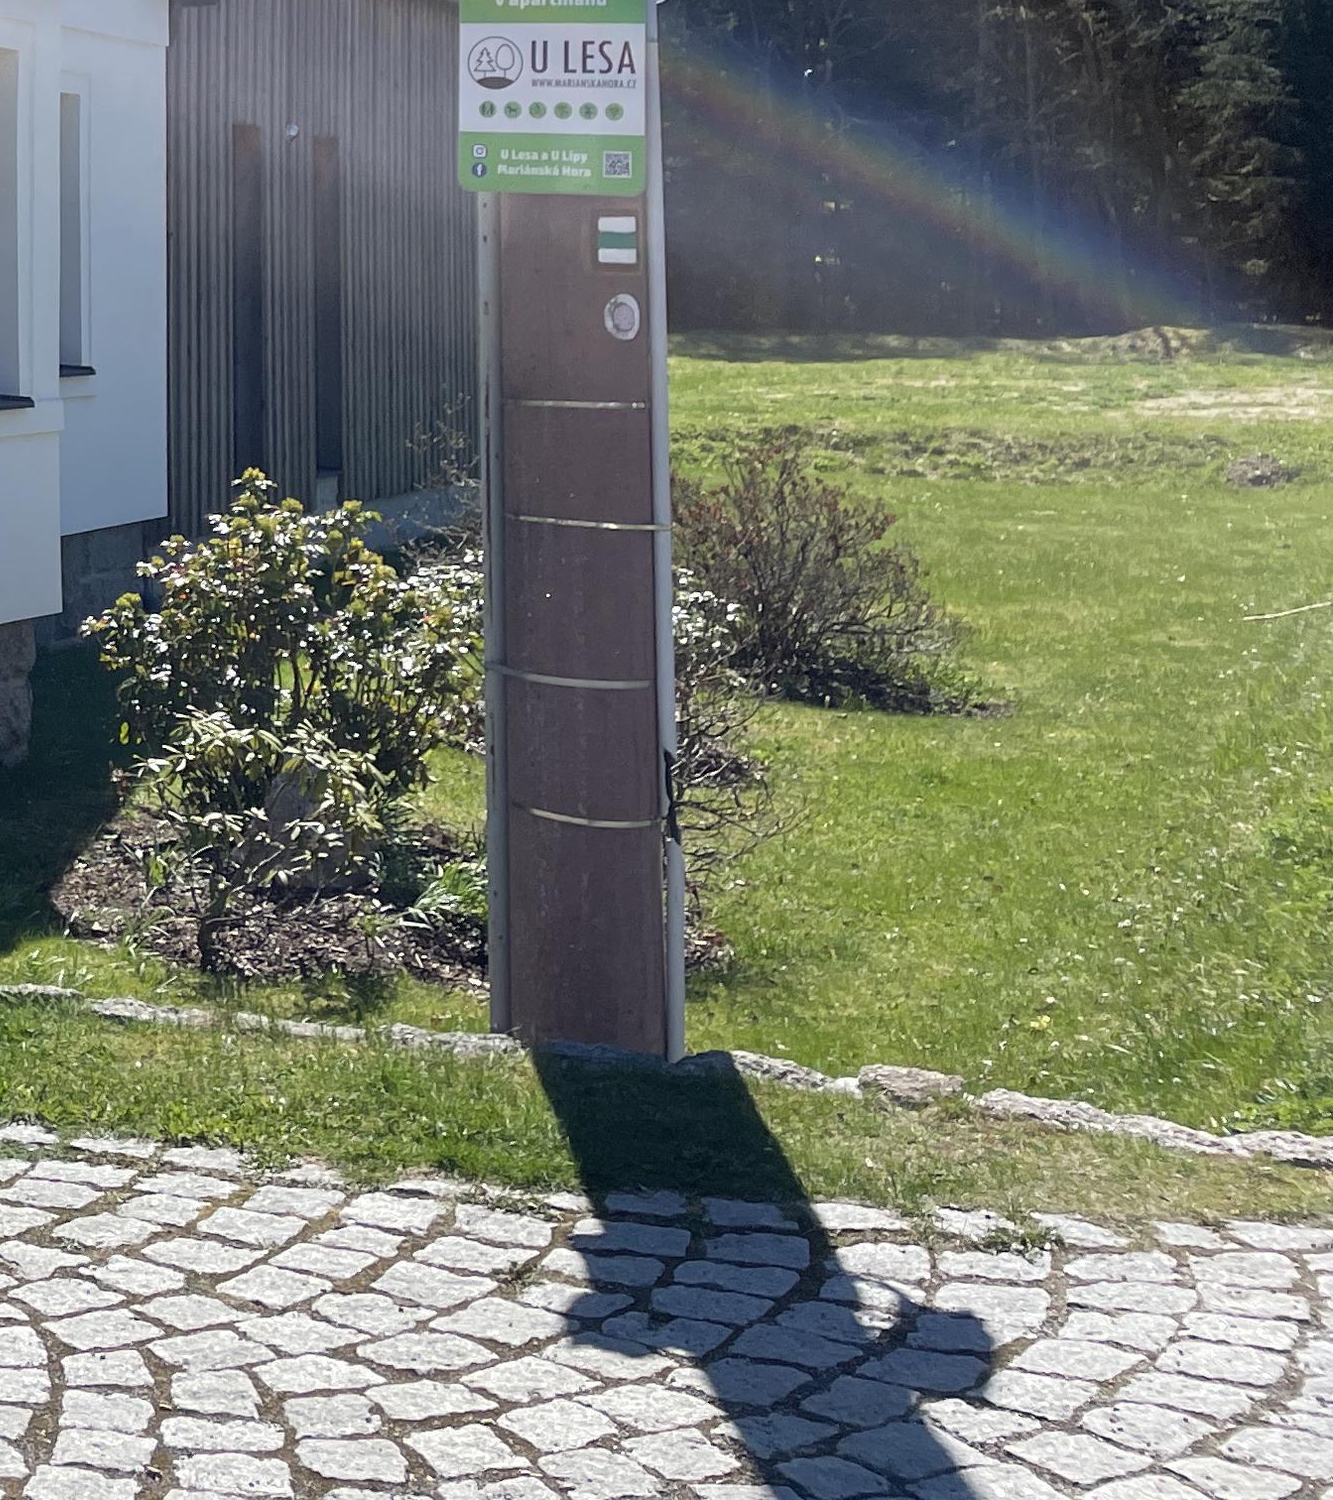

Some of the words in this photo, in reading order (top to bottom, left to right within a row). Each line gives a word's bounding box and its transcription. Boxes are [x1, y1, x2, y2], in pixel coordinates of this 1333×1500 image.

[531, 40, 548, 73] U
[564, 40, 636, 74] LESA
[501, 149, 509, 160] U
[511, 149, 539, 160] Lesa
[541, 152, 549, 160] a
[551, 150, 559, 160] U
[561, 150, 588, 164] Lipy
[497, 164, 559, 176] Mariánská
[562, 166, 591, 177] Hora
